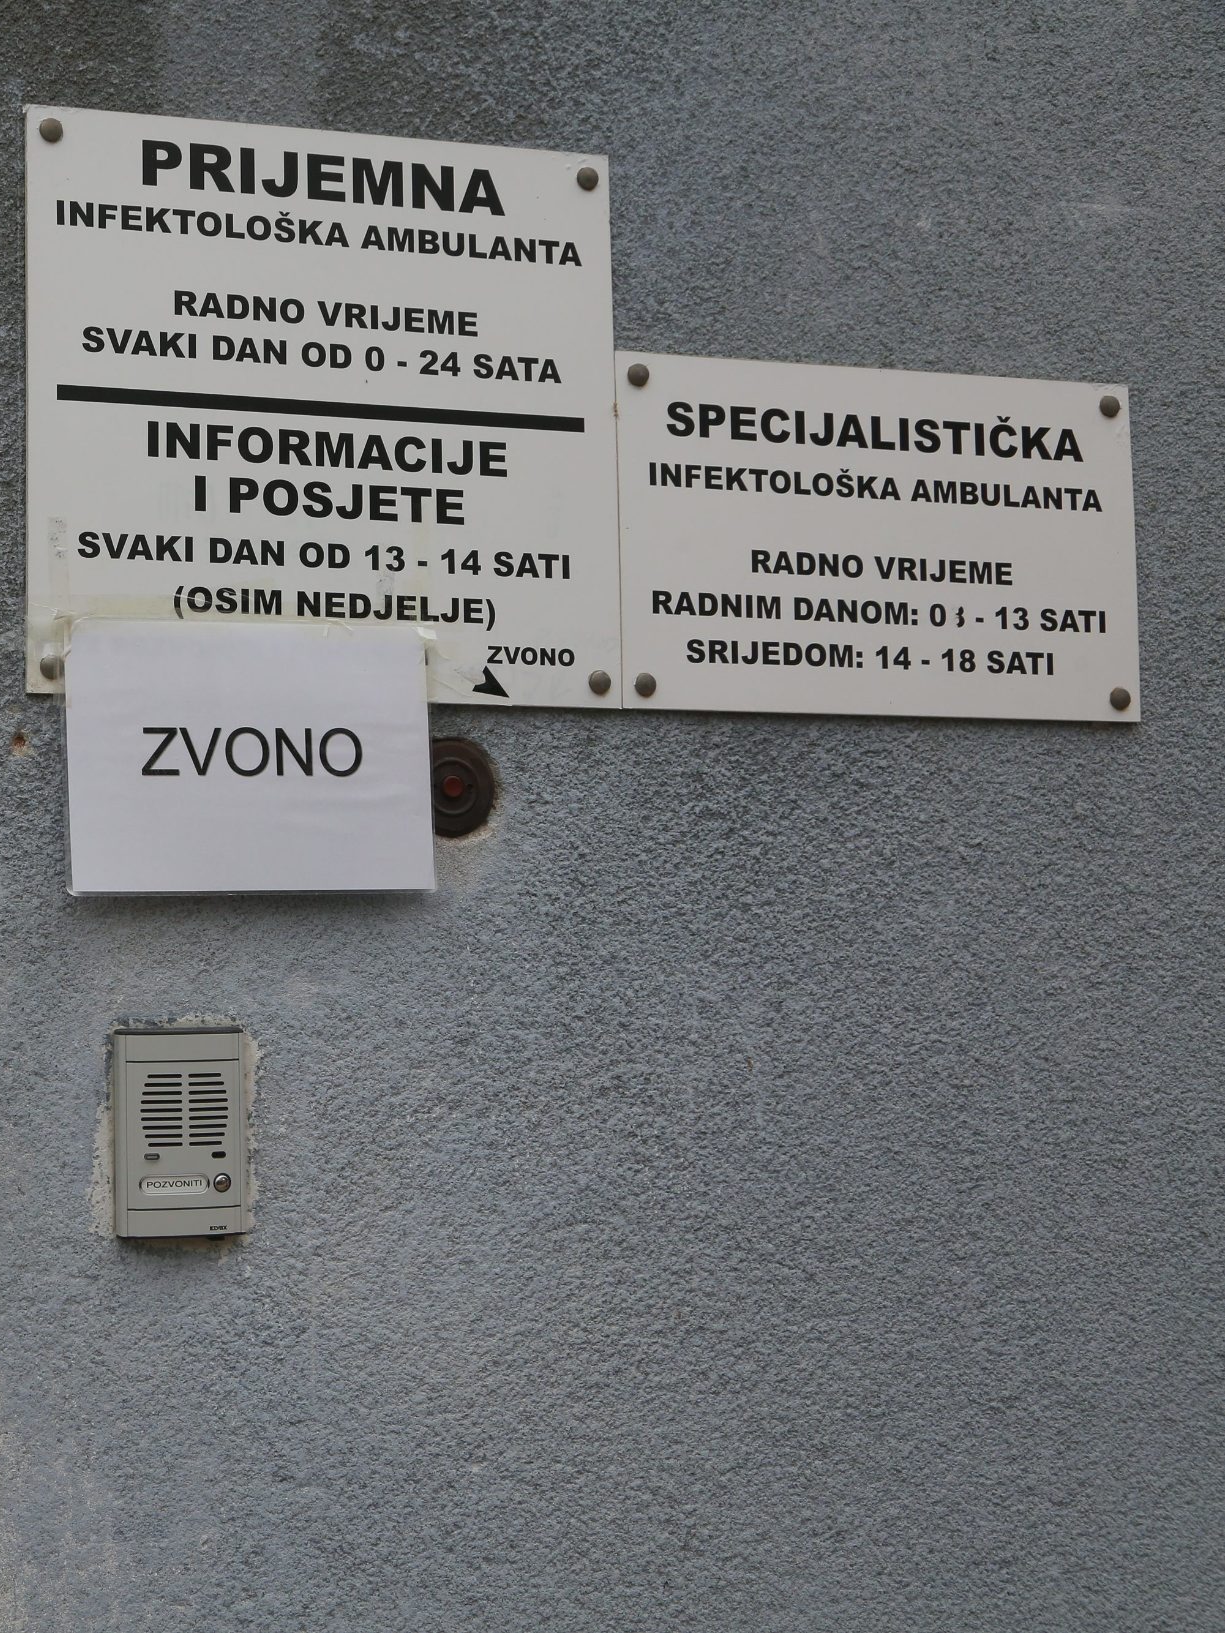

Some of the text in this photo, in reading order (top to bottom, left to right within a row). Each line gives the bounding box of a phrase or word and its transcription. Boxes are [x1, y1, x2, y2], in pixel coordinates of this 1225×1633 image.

[142, 140, 505, 216] PRIJEMNA
[57, 200, 582, 266] INFEKTOLOŠKA AMBULANTA
[175, 290, 478, 337] RADNO VRIJEME
[82, 327, 196, 358] SVAKI
[213, 335, 286, 365] DAN
[302, 342, 351, 368] OD
[365, 347, 384, 371] 0
[420, 350, 460, 376] 24
[474, 354, 561, 383] SATA
[148, 421, 507, 477] INFORMACIJE
[667, 402, 1083, 462] SPECIJALISTIČKA
[195, 476, 464, 525] I POSJETE
[650, 462, 1102, 512] INFEKTOLOŠKA AMBULANTA
[78, 532, 193, 562] SVAKI
[210, 538, 284, 566] DAN
[300, 542, 350, 568] OD
[365, 545, 405, 571] 13
[441, 549, 481, 575] 14
[494, 552, 569, 579] SATI
[752, 550, 1012, 585] RADNO VRIJEME
[174, 586, 495, 631] (OSIM NEDJELJE)
[653, 591, 780, 619] RADNIM
[794, 597, 917, 625] DANOM:
[996, 607, 1029, 630] 13
[1040, 609, 1105, 633] SATI
[487, 646, 574, 666] ZVONO
[687, 639, 863, 668] SRIJEDOM:
[876, 646, 911, 670] 14
[942, 649, 976, 672] 18
[987, 651, 1053, 675] SATI
[142, 727, 362, 777] ZVONO
[146, 1179, 203, 1188] POZVONITI
